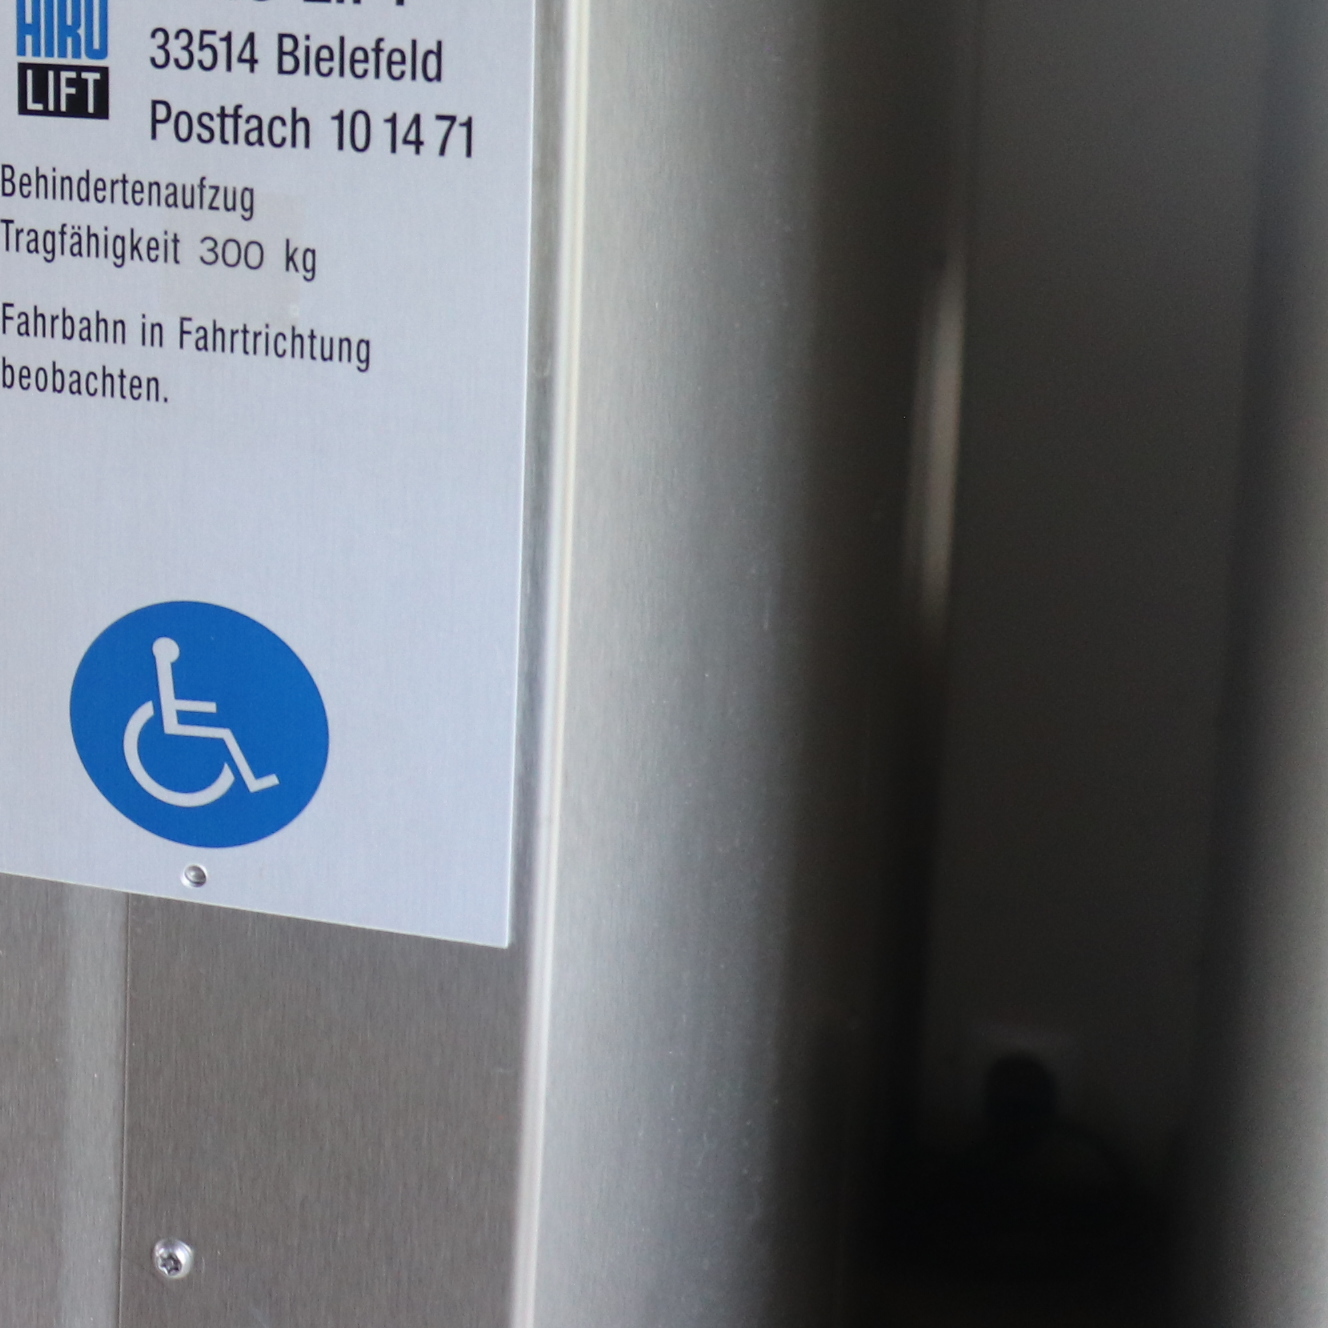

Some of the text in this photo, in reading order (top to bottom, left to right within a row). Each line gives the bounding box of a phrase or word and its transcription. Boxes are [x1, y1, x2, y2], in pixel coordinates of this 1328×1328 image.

[150, 27, 442, 83] 33514 Bielefeld
[27, 70, 100, 113] LIFT
[151, 99, 310, 149] Postfach
[0, 164, 254, 221] Behindertenaufzug
[0, 219, 316, 282] Tragfähigkeit 300 kg
[2, 302, 370, 373] Fahrbahn in Fahrtrichtung
[2, 356, 168, 403] beobachten.
